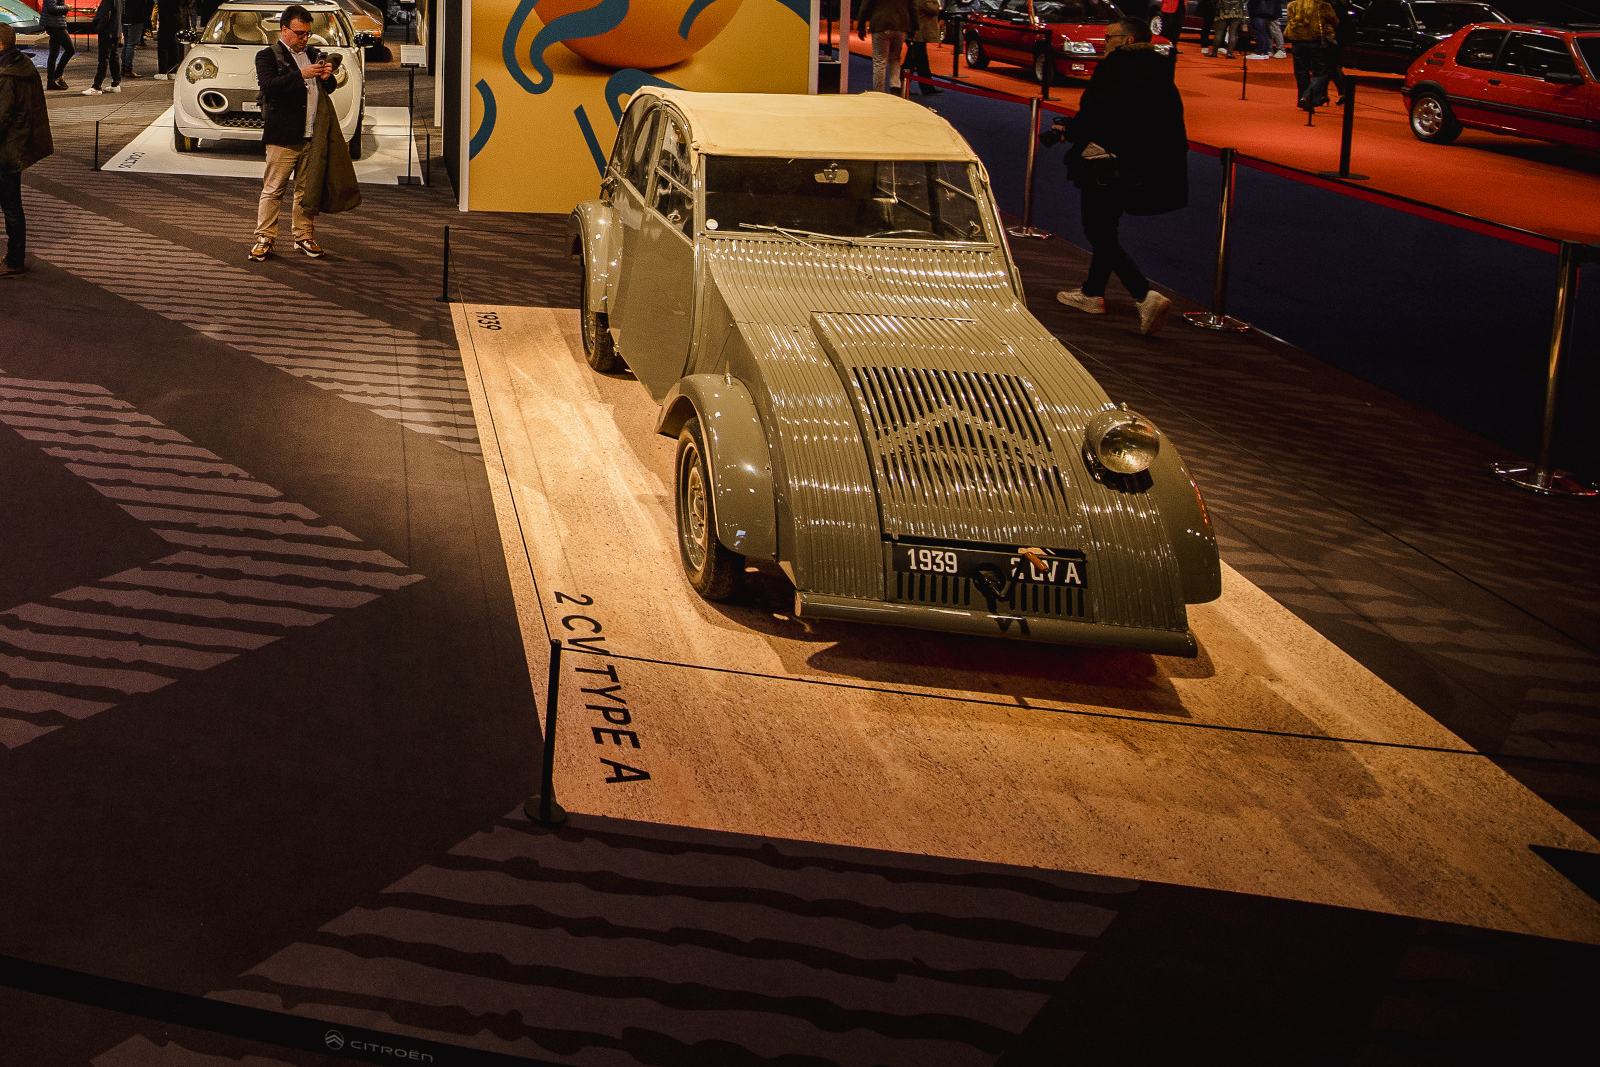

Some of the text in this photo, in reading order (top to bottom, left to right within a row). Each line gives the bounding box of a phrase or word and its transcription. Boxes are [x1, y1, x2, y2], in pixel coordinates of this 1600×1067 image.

[475, 311, 502, 330] 1939
[907, 548, 958, 574] 1939
[554, 591, 651, 784] 2 CV TYPE A
